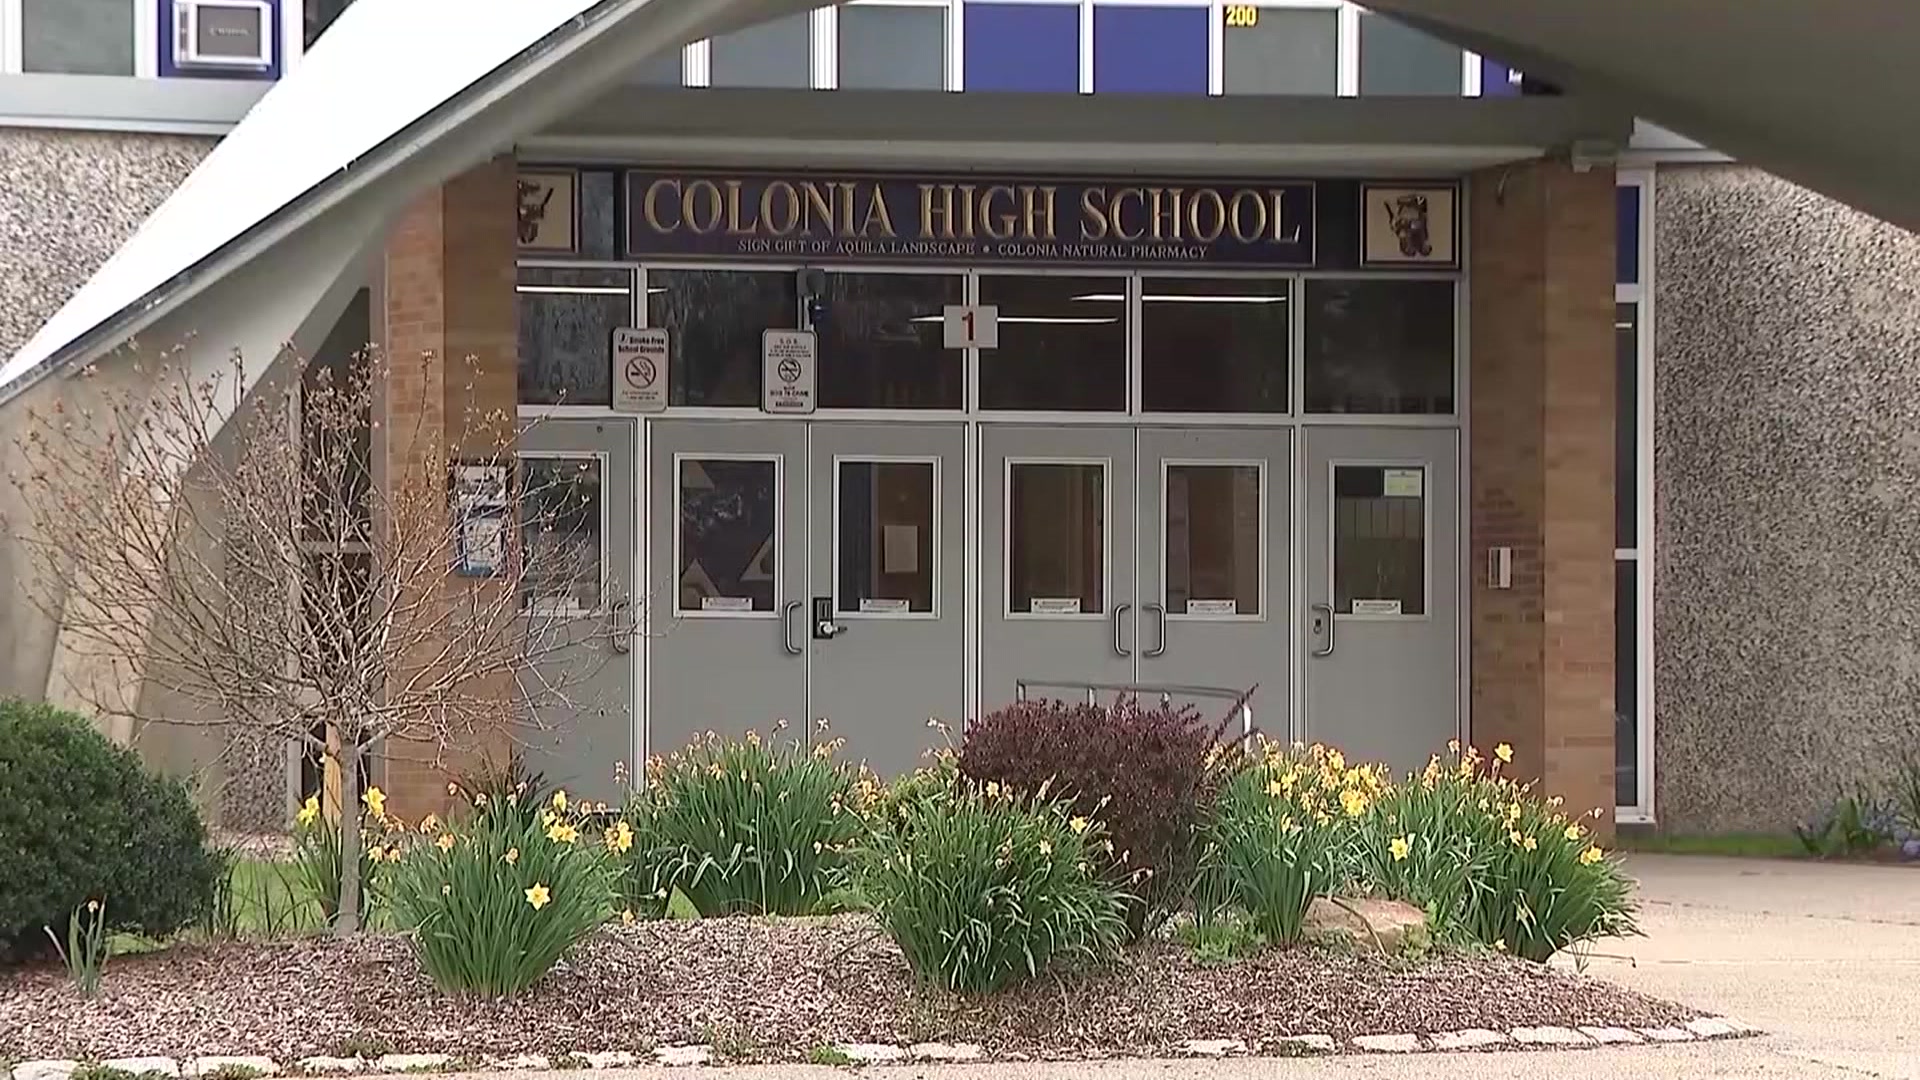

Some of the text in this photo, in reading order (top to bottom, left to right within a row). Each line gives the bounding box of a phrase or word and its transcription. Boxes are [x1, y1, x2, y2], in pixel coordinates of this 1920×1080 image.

[1226, 4, 1257, 26] 200
[643, 179, 1300, 243] COLONIA HIGH SCHOOL
[738, 239, 1207, 259] SIGN GIFT OF AQUILA LANDSCAPE COLONIA NATURAL PHARMACY
[961, 311, 974, 341] 1
